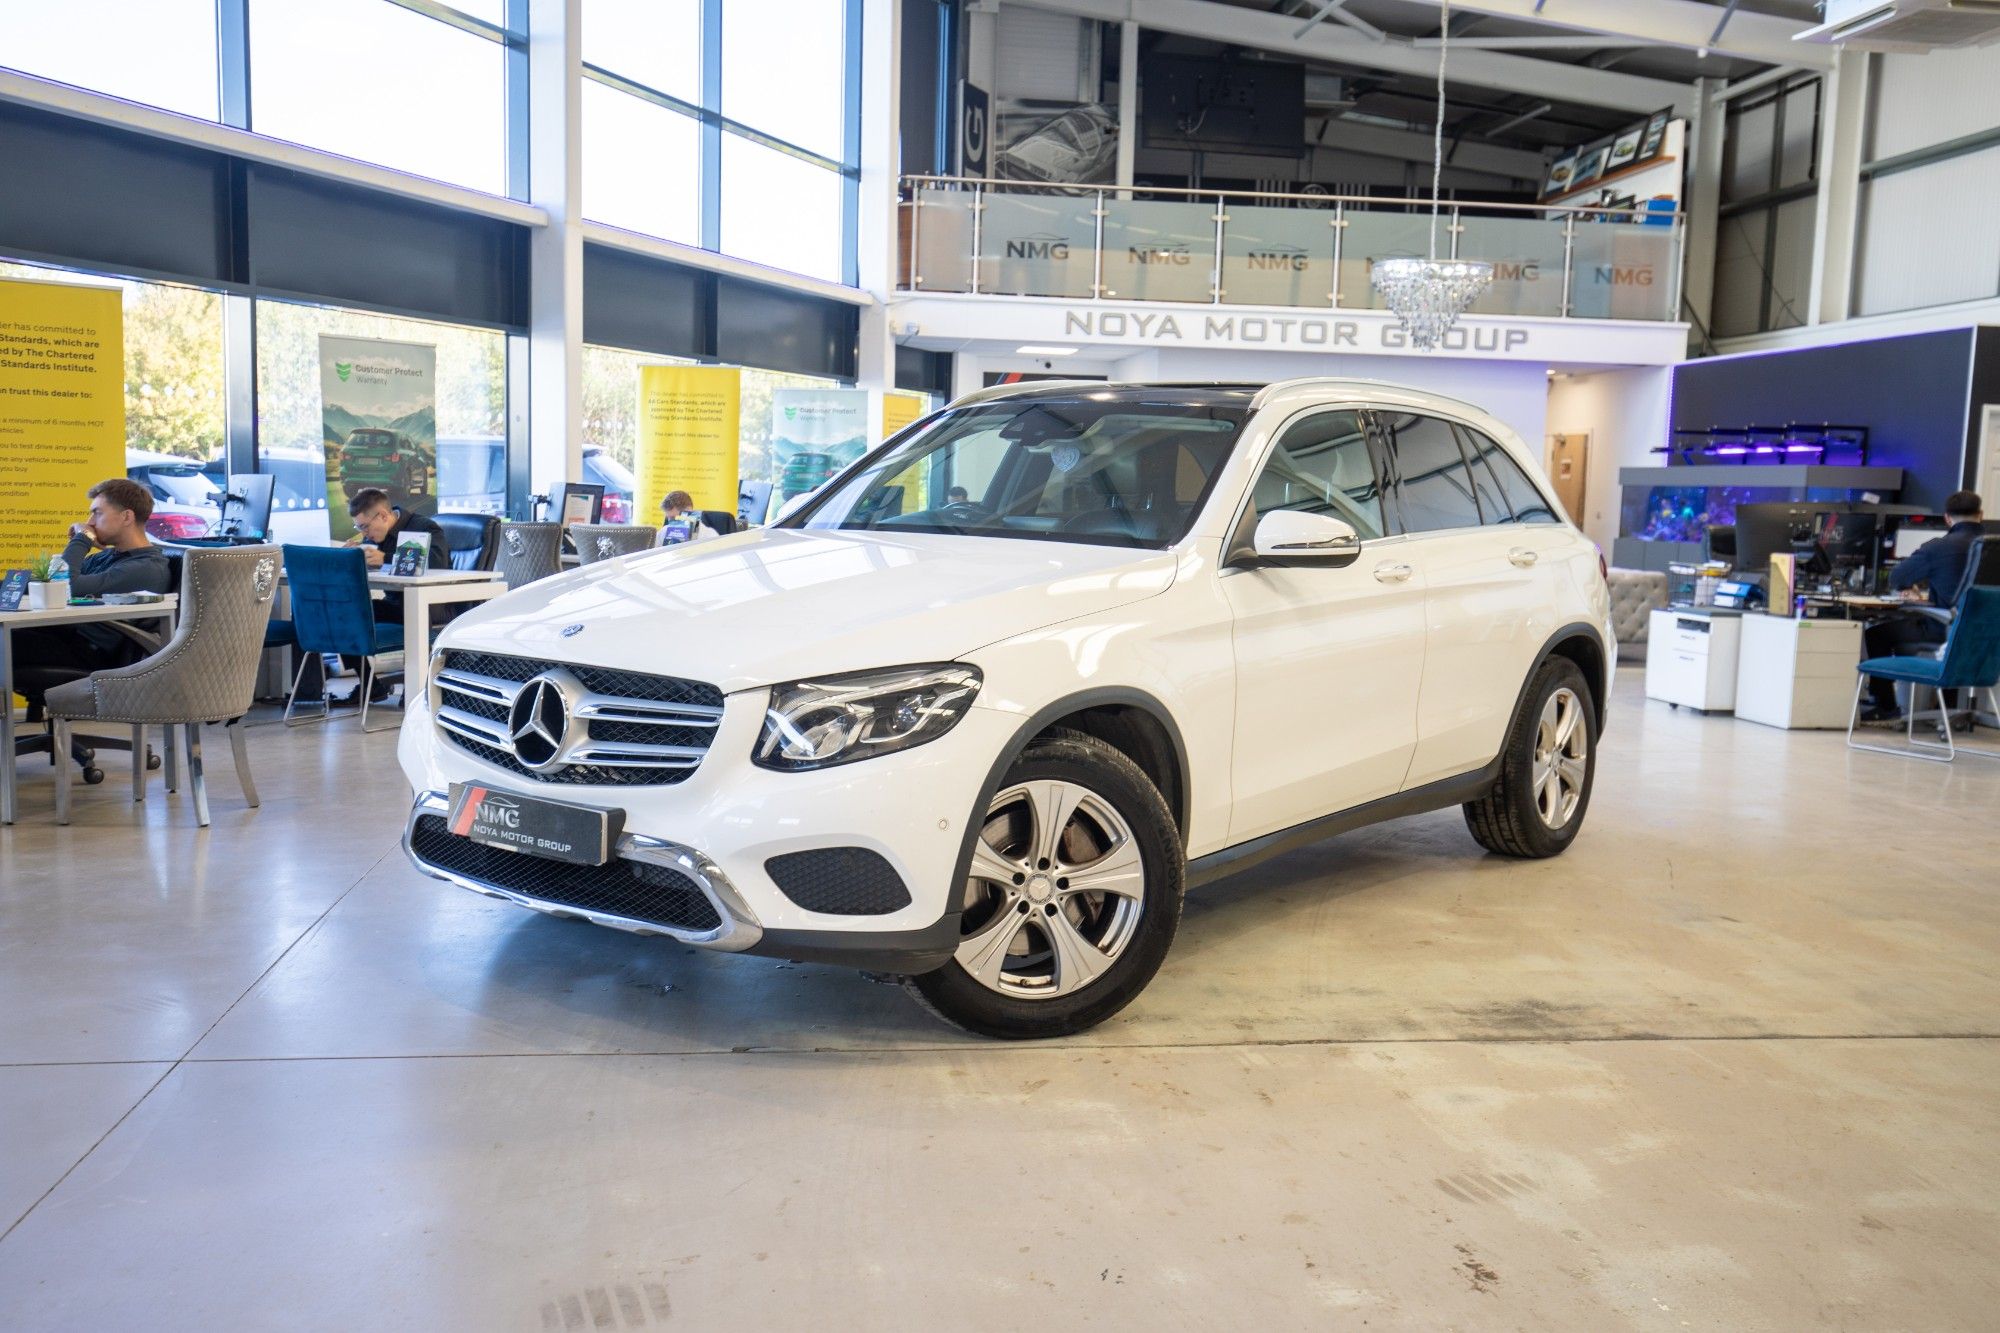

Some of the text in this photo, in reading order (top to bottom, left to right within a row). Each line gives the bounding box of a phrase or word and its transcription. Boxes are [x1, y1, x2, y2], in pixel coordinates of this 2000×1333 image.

[1005, 240, 1069, 260] NMG
[1128, 246, 1190, 265] NMG
[1247, 252, 1308, 271] NMG
[1594, 266, 1653, 286] NMG
[14, 322, 31, 332] has
[33, 324, 84, 335] committed
[87, 328, 97, 336] to
[1065, 310, 1529, 351] NOYA MOTOR GOUP
[53, 338, 82, 348] which
[11, 347, 24, 358] by
[25, 348, 44, 358] The
[46, 349, 95, 361] Chartered
[0, 359, 97, 373] Standards Institute.
[355, 364, 424, 377] Customer Protect
[9, 387, 31, 396] trust
[32, 388, 49, 397] this
[51, 389, 79, 399] dealer
[9, 417, 42, 426] minimum
[474, 801, 520, 828] NMG
[473, 824, 572, 852] NOYA MOTOR GROUP
